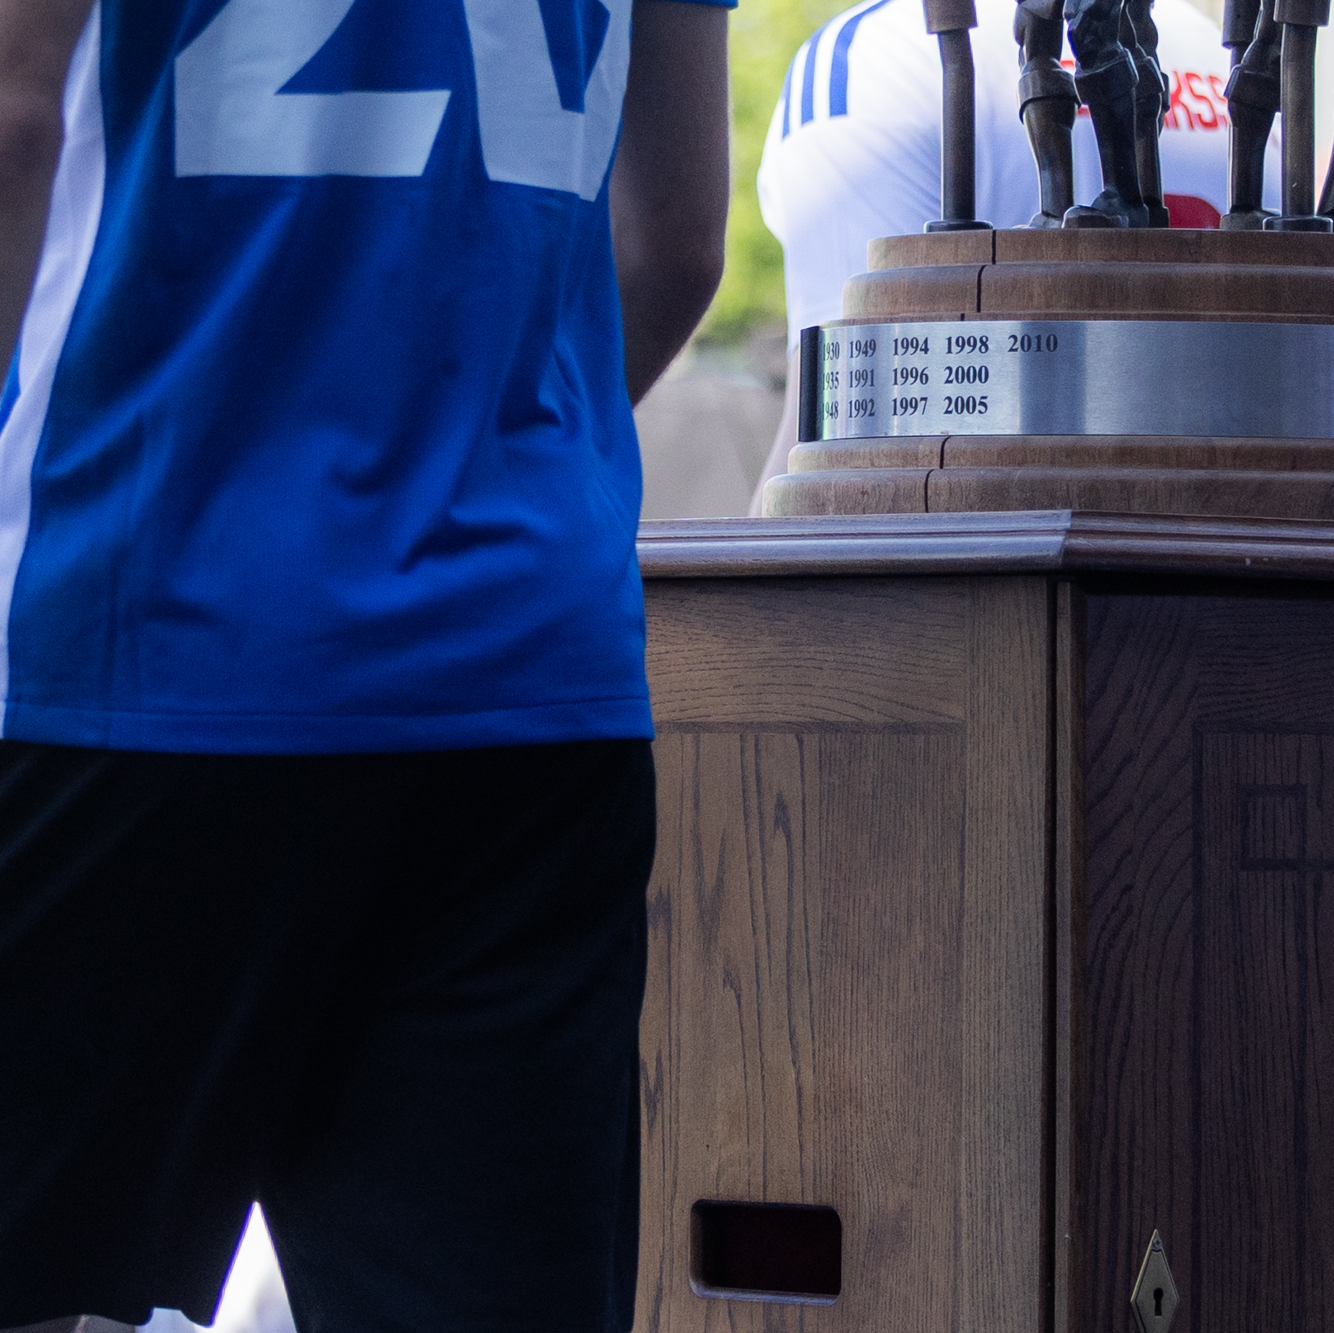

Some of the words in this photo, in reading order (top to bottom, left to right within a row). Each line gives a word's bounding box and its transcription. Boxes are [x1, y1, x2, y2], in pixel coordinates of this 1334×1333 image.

[849, 338, 877, 359] 1949
[892, 336, 930, 356] 1994
[945, 334, 990, 355] 1998
[1007, 333, 1059, 353] 2010
[848, 368, 875, 388] 1991
[892, 366, 929, 386] 1996
[943, 365, 989, 385] 2000
[848, 397, 875, 418] 1992
[891, 396, 928, 416] 1997
[943, 395, 989, 415] 2005
